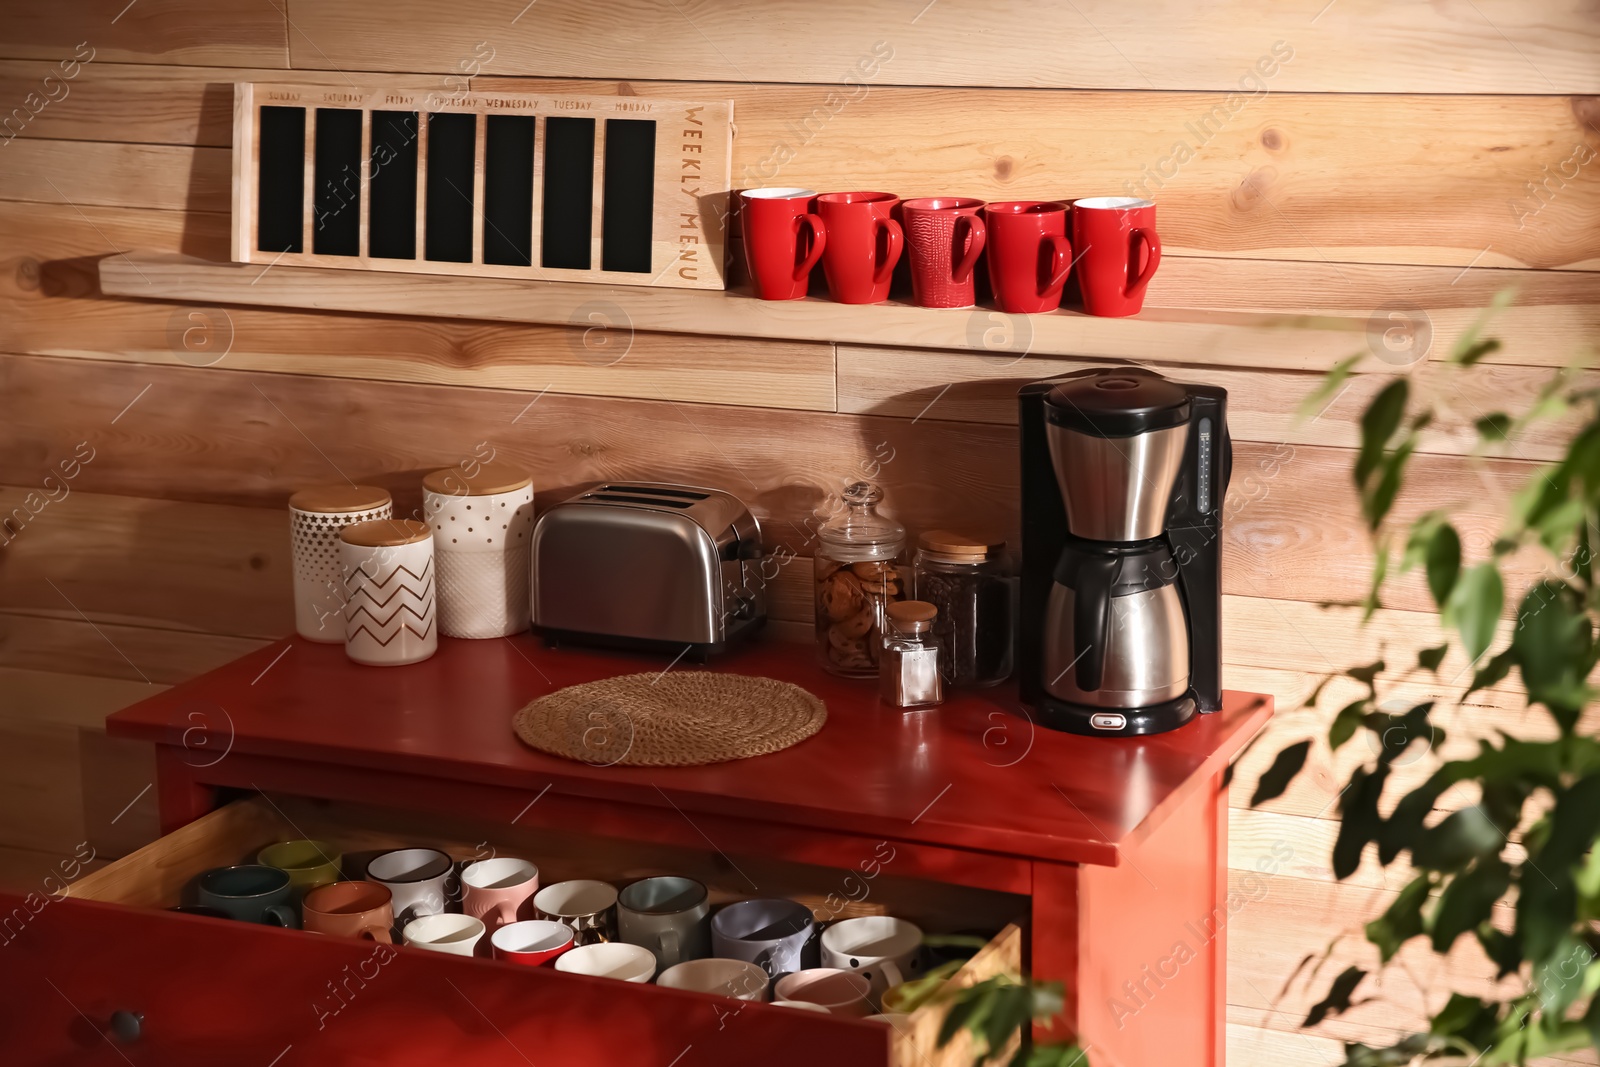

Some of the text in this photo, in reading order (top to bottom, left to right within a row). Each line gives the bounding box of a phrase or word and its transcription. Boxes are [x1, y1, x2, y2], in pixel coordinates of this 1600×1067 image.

[268, 90, 302, 101] SUNDAY
[323, 92, 363, 104] SATURDAY
[385, 95, 415, 105] FRIDAY
[433, 97, 479, 108] THURSDAY
[485, 98, 539, 110] WEDNESDAY
[553, 100, 592, 111] TUESDAY
[614, 102, 653, 113] MONDAY
[678, 106, 704, 281] WEEKLY MENU
